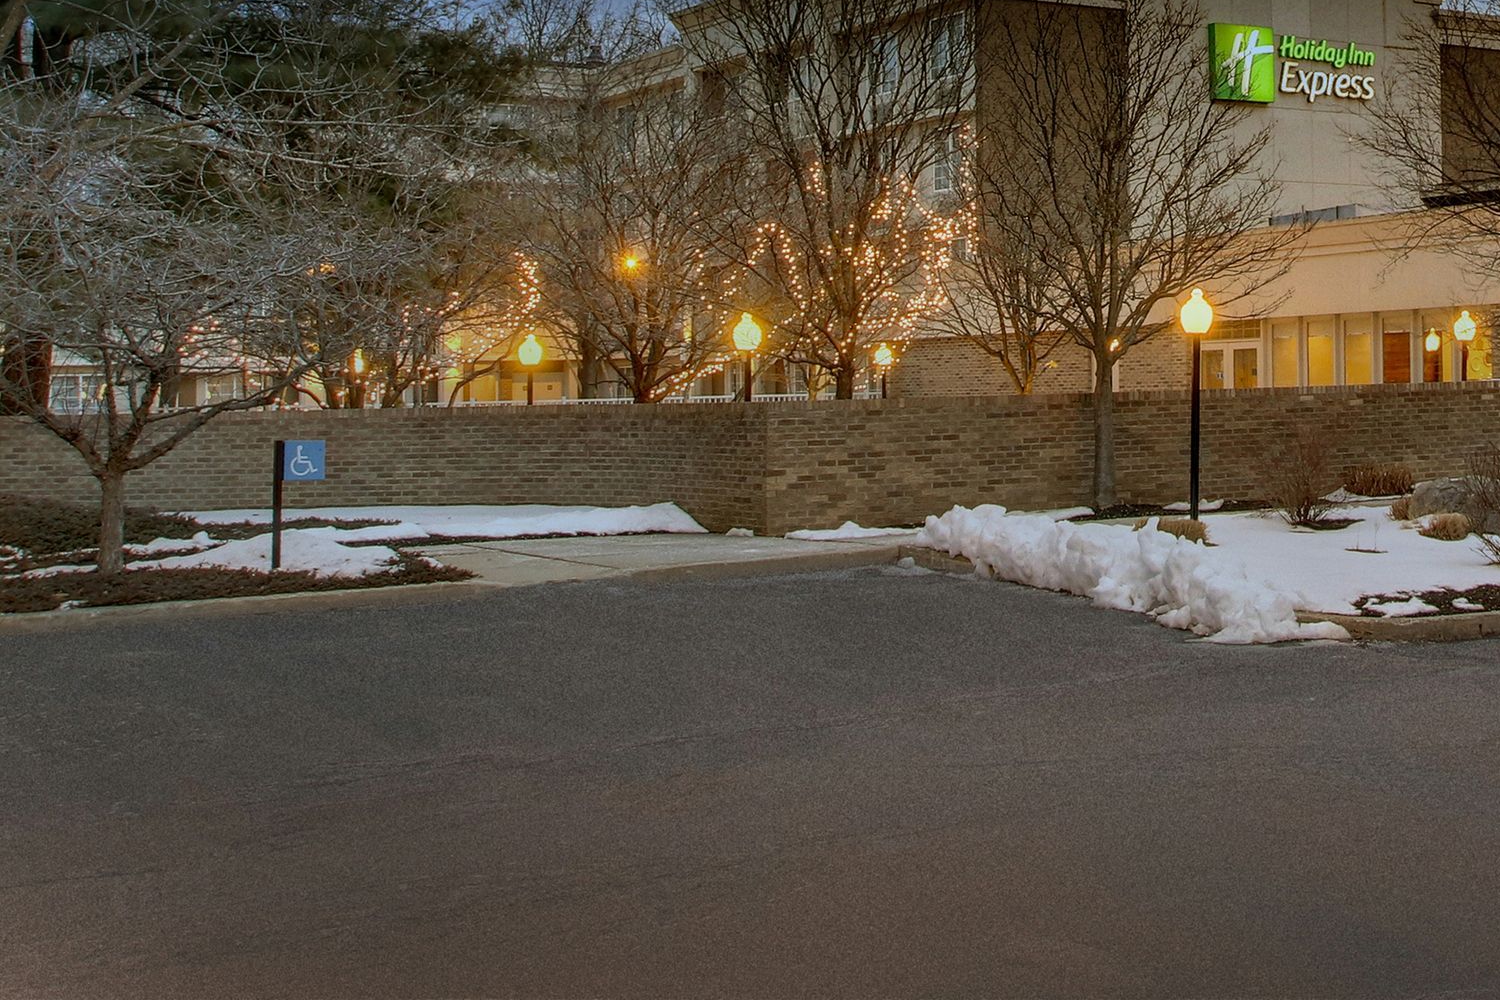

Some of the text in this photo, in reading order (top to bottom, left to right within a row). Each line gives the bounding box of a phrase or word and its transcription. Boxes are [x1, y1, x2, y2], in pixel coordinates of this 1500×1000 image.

[1280, 35, 1375, 68] Holiday Inn
[1280, 61, 1376, 103] Express
